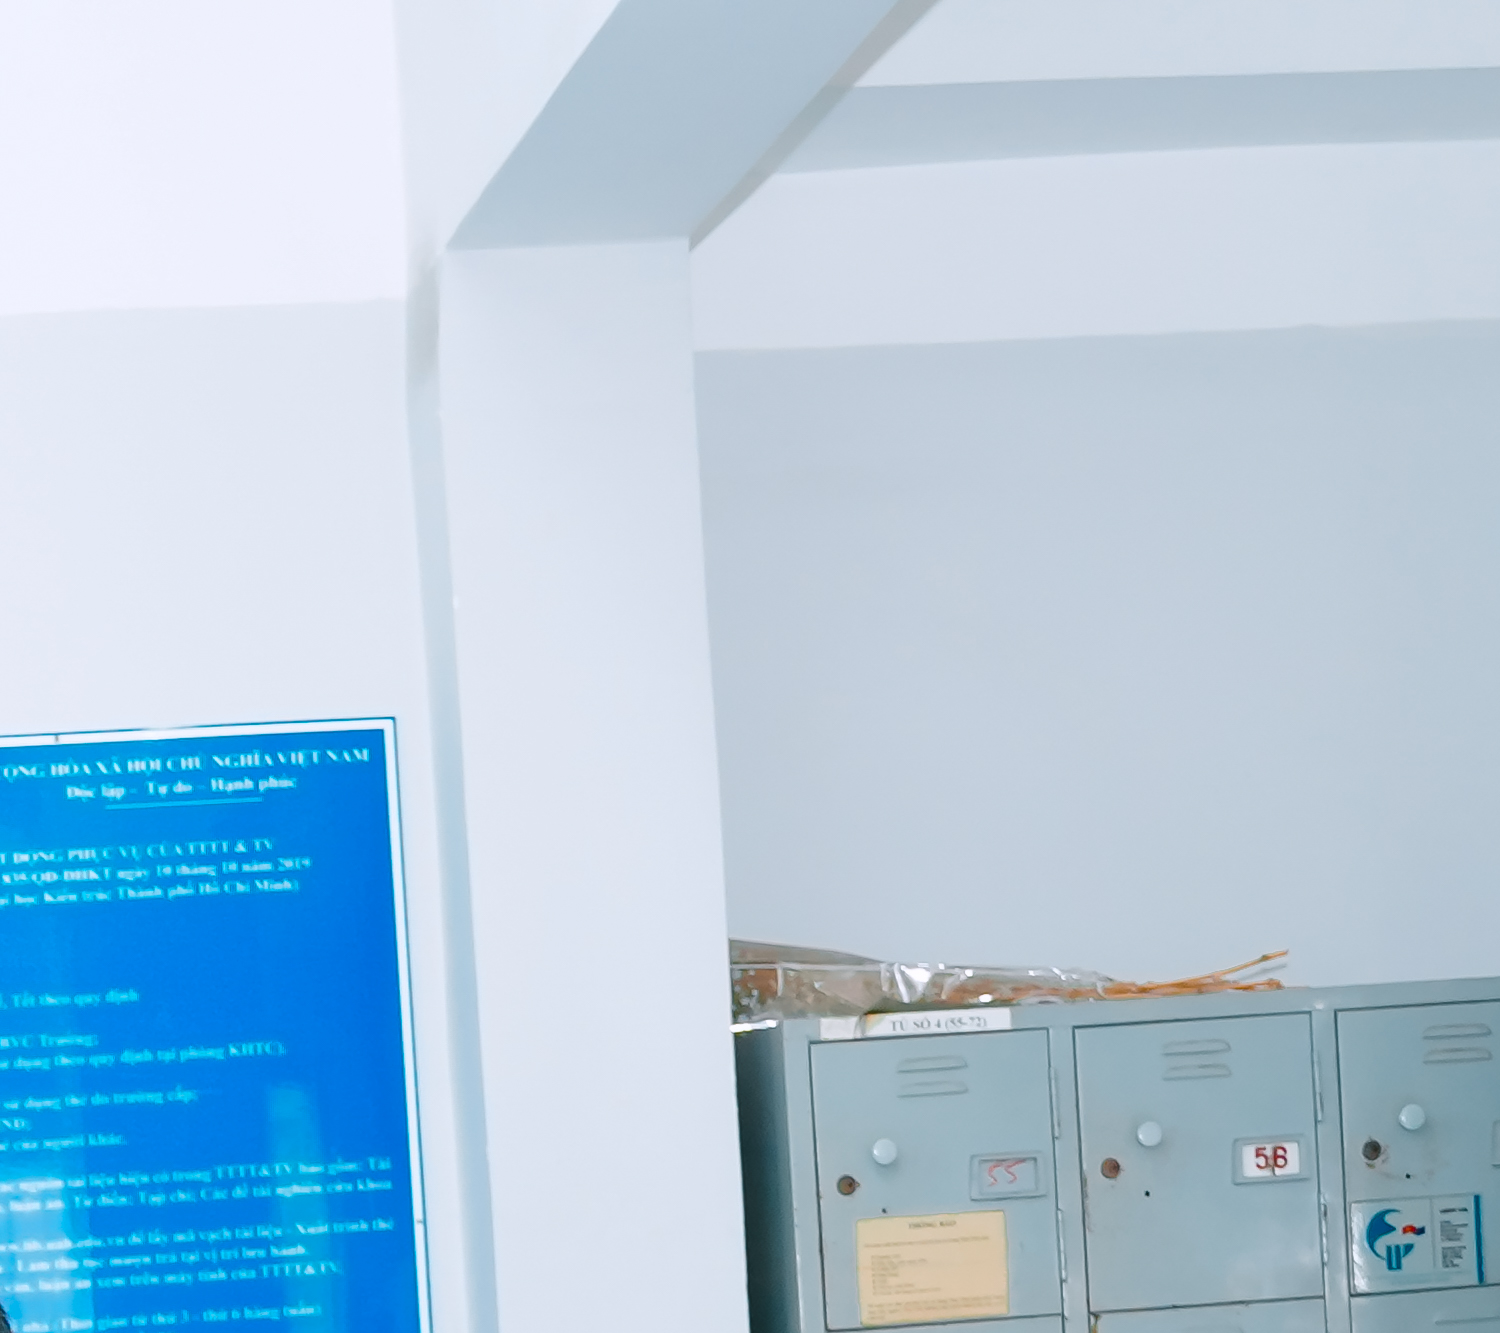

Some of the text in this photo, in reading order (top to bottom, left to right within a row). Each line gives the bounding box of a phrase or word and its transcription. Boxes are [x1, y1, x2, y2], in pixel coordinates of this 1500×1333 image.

[934, 1018, 943, 1030] 4
[986, 1158, 1028, 1188] 55
[1253, 1143, 1289, 1175] 56
